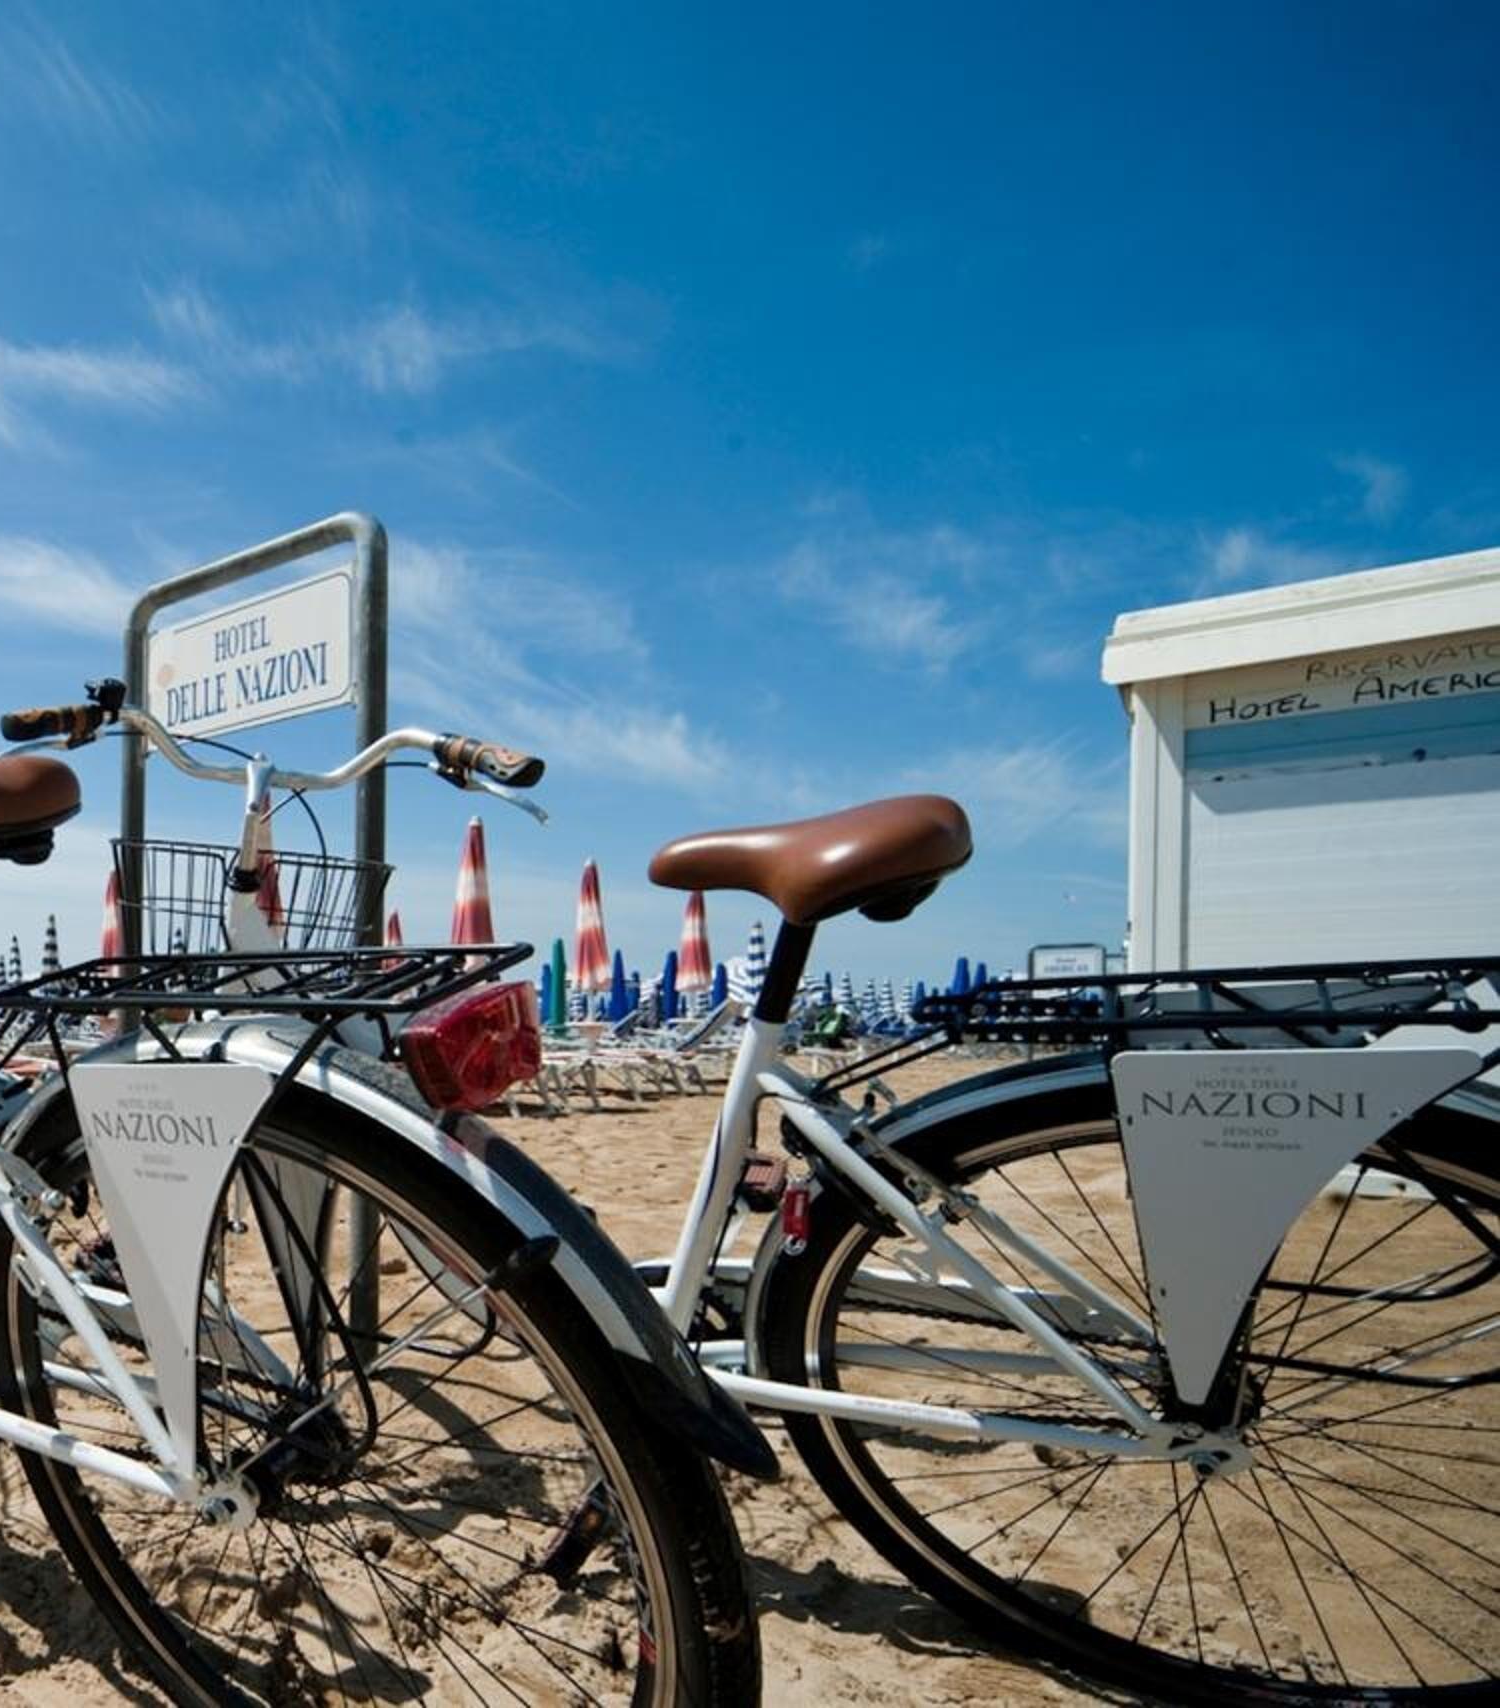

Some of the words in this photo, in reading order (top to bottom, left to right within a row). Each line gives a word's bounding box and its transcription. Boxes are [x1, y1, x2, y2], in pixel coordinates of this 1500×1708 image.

[214, 616, 271, 662] HOTEL
[166, 672, 228, 727] DELLE
[236, 642, 328, 708] NAZIONI
[1209, 693, 1321, 723] HOTEL
[1141, 1090, 1366, 1119] NAZIONI
[92, 1111, 218, 1148] NAZIONI
